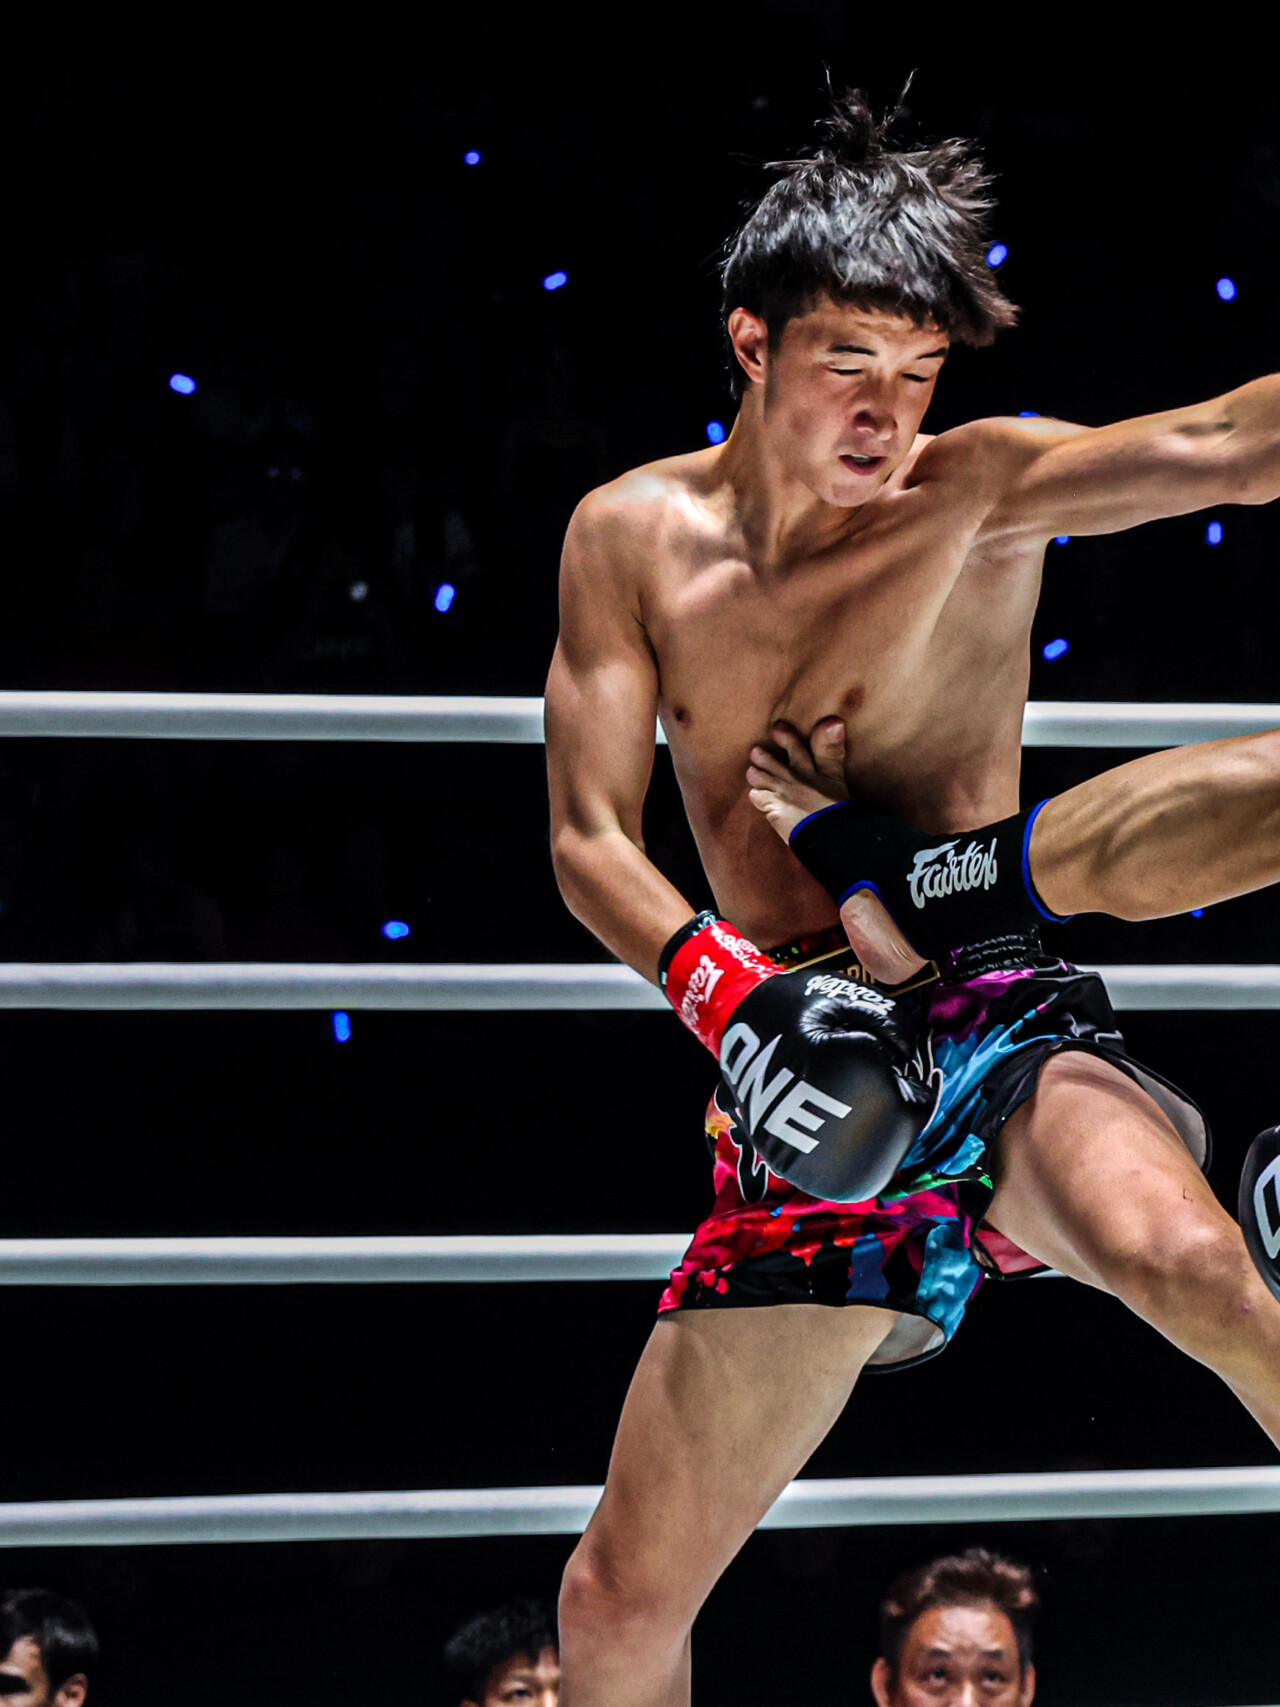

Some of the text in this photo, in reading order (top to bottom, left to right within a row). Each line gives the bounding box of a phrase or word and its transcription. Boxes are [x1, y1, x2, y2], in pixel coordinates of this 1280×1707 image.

[906, 837, 998, 909] Fairtex
[804, 974, 897, 1016] Fairtex
[720, 1021, 853, 1155] ONE
